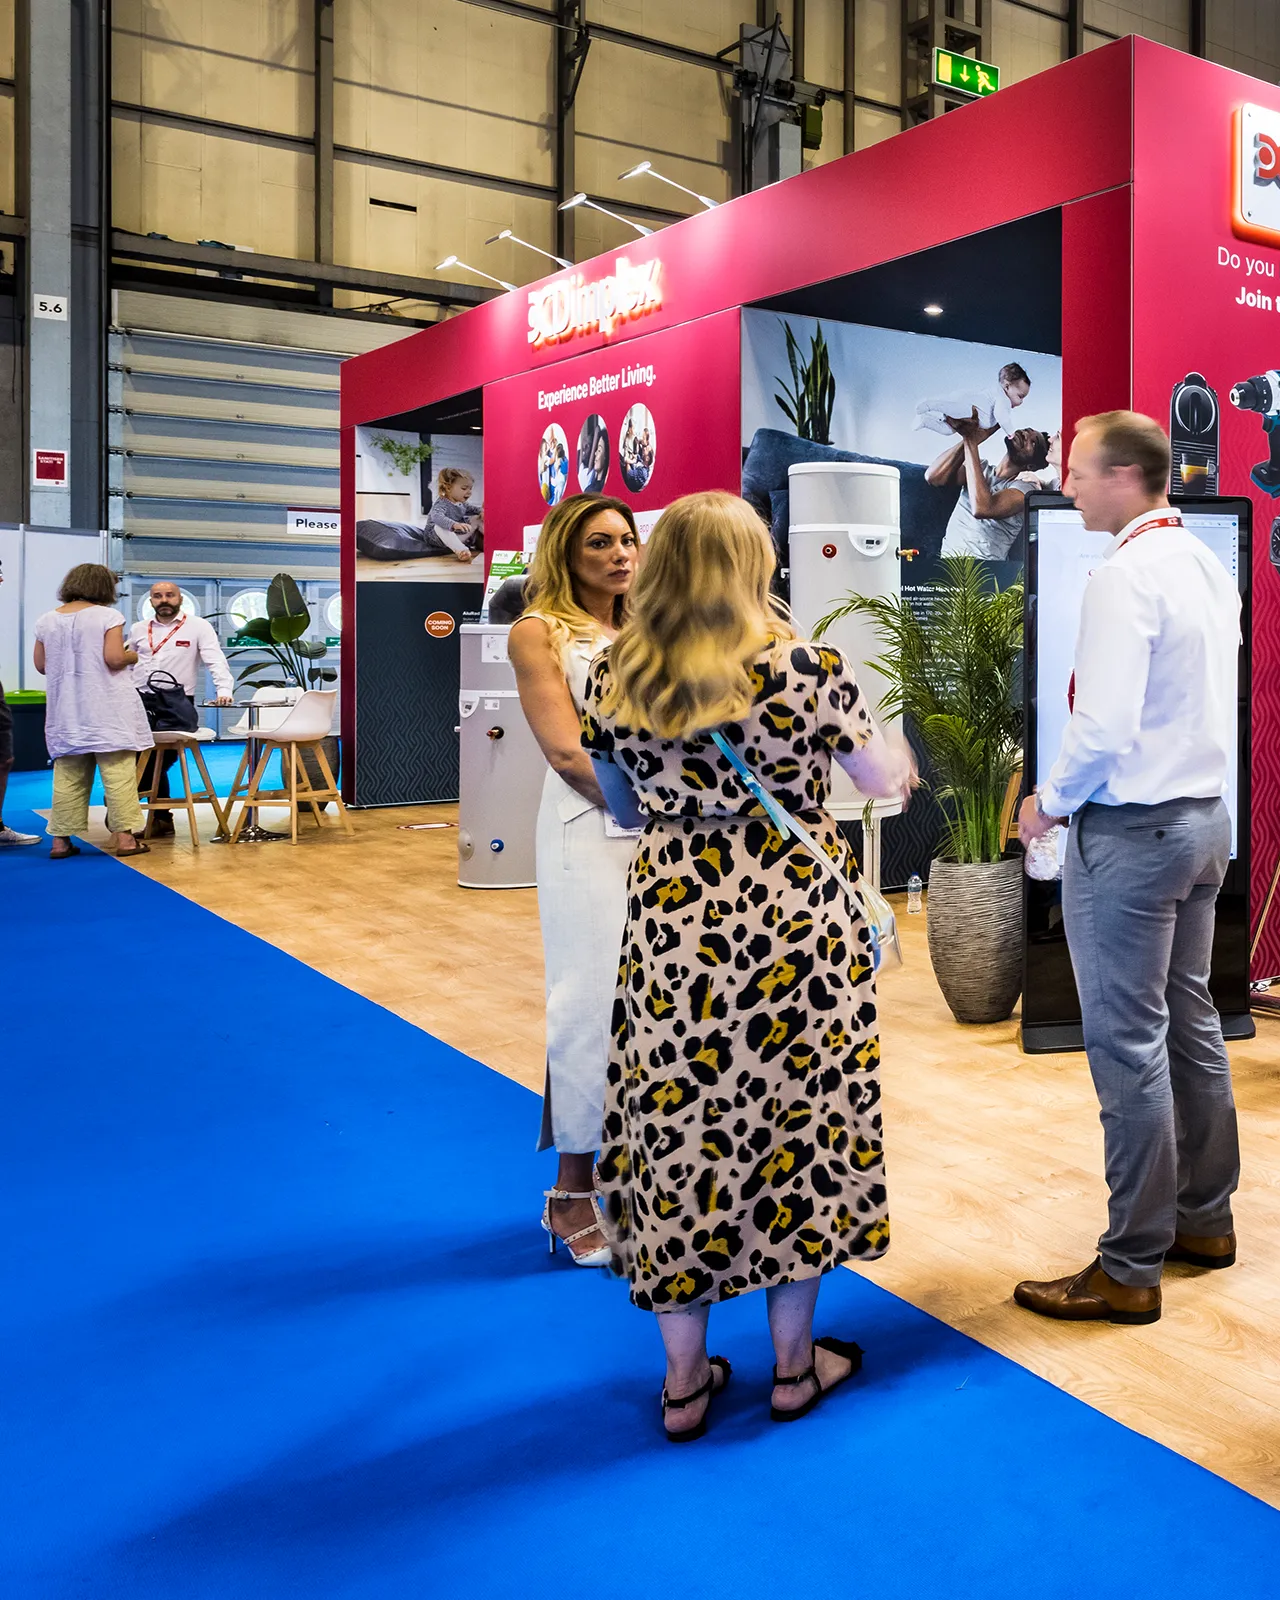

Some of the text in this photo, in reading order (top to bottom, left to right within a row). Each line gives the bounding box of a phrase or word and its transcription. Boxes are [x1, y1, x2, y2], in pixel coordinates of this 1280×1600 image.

[1218, 246, 1241, 269] Do
[1245, 257, 1275, 277] you
[39, 301, 63, 314] 5.6
[1235, 286, 1272, 312] Join
[538, 363, 657, 412] Experience Better Living.
[296, 518, 338, 530] Please
